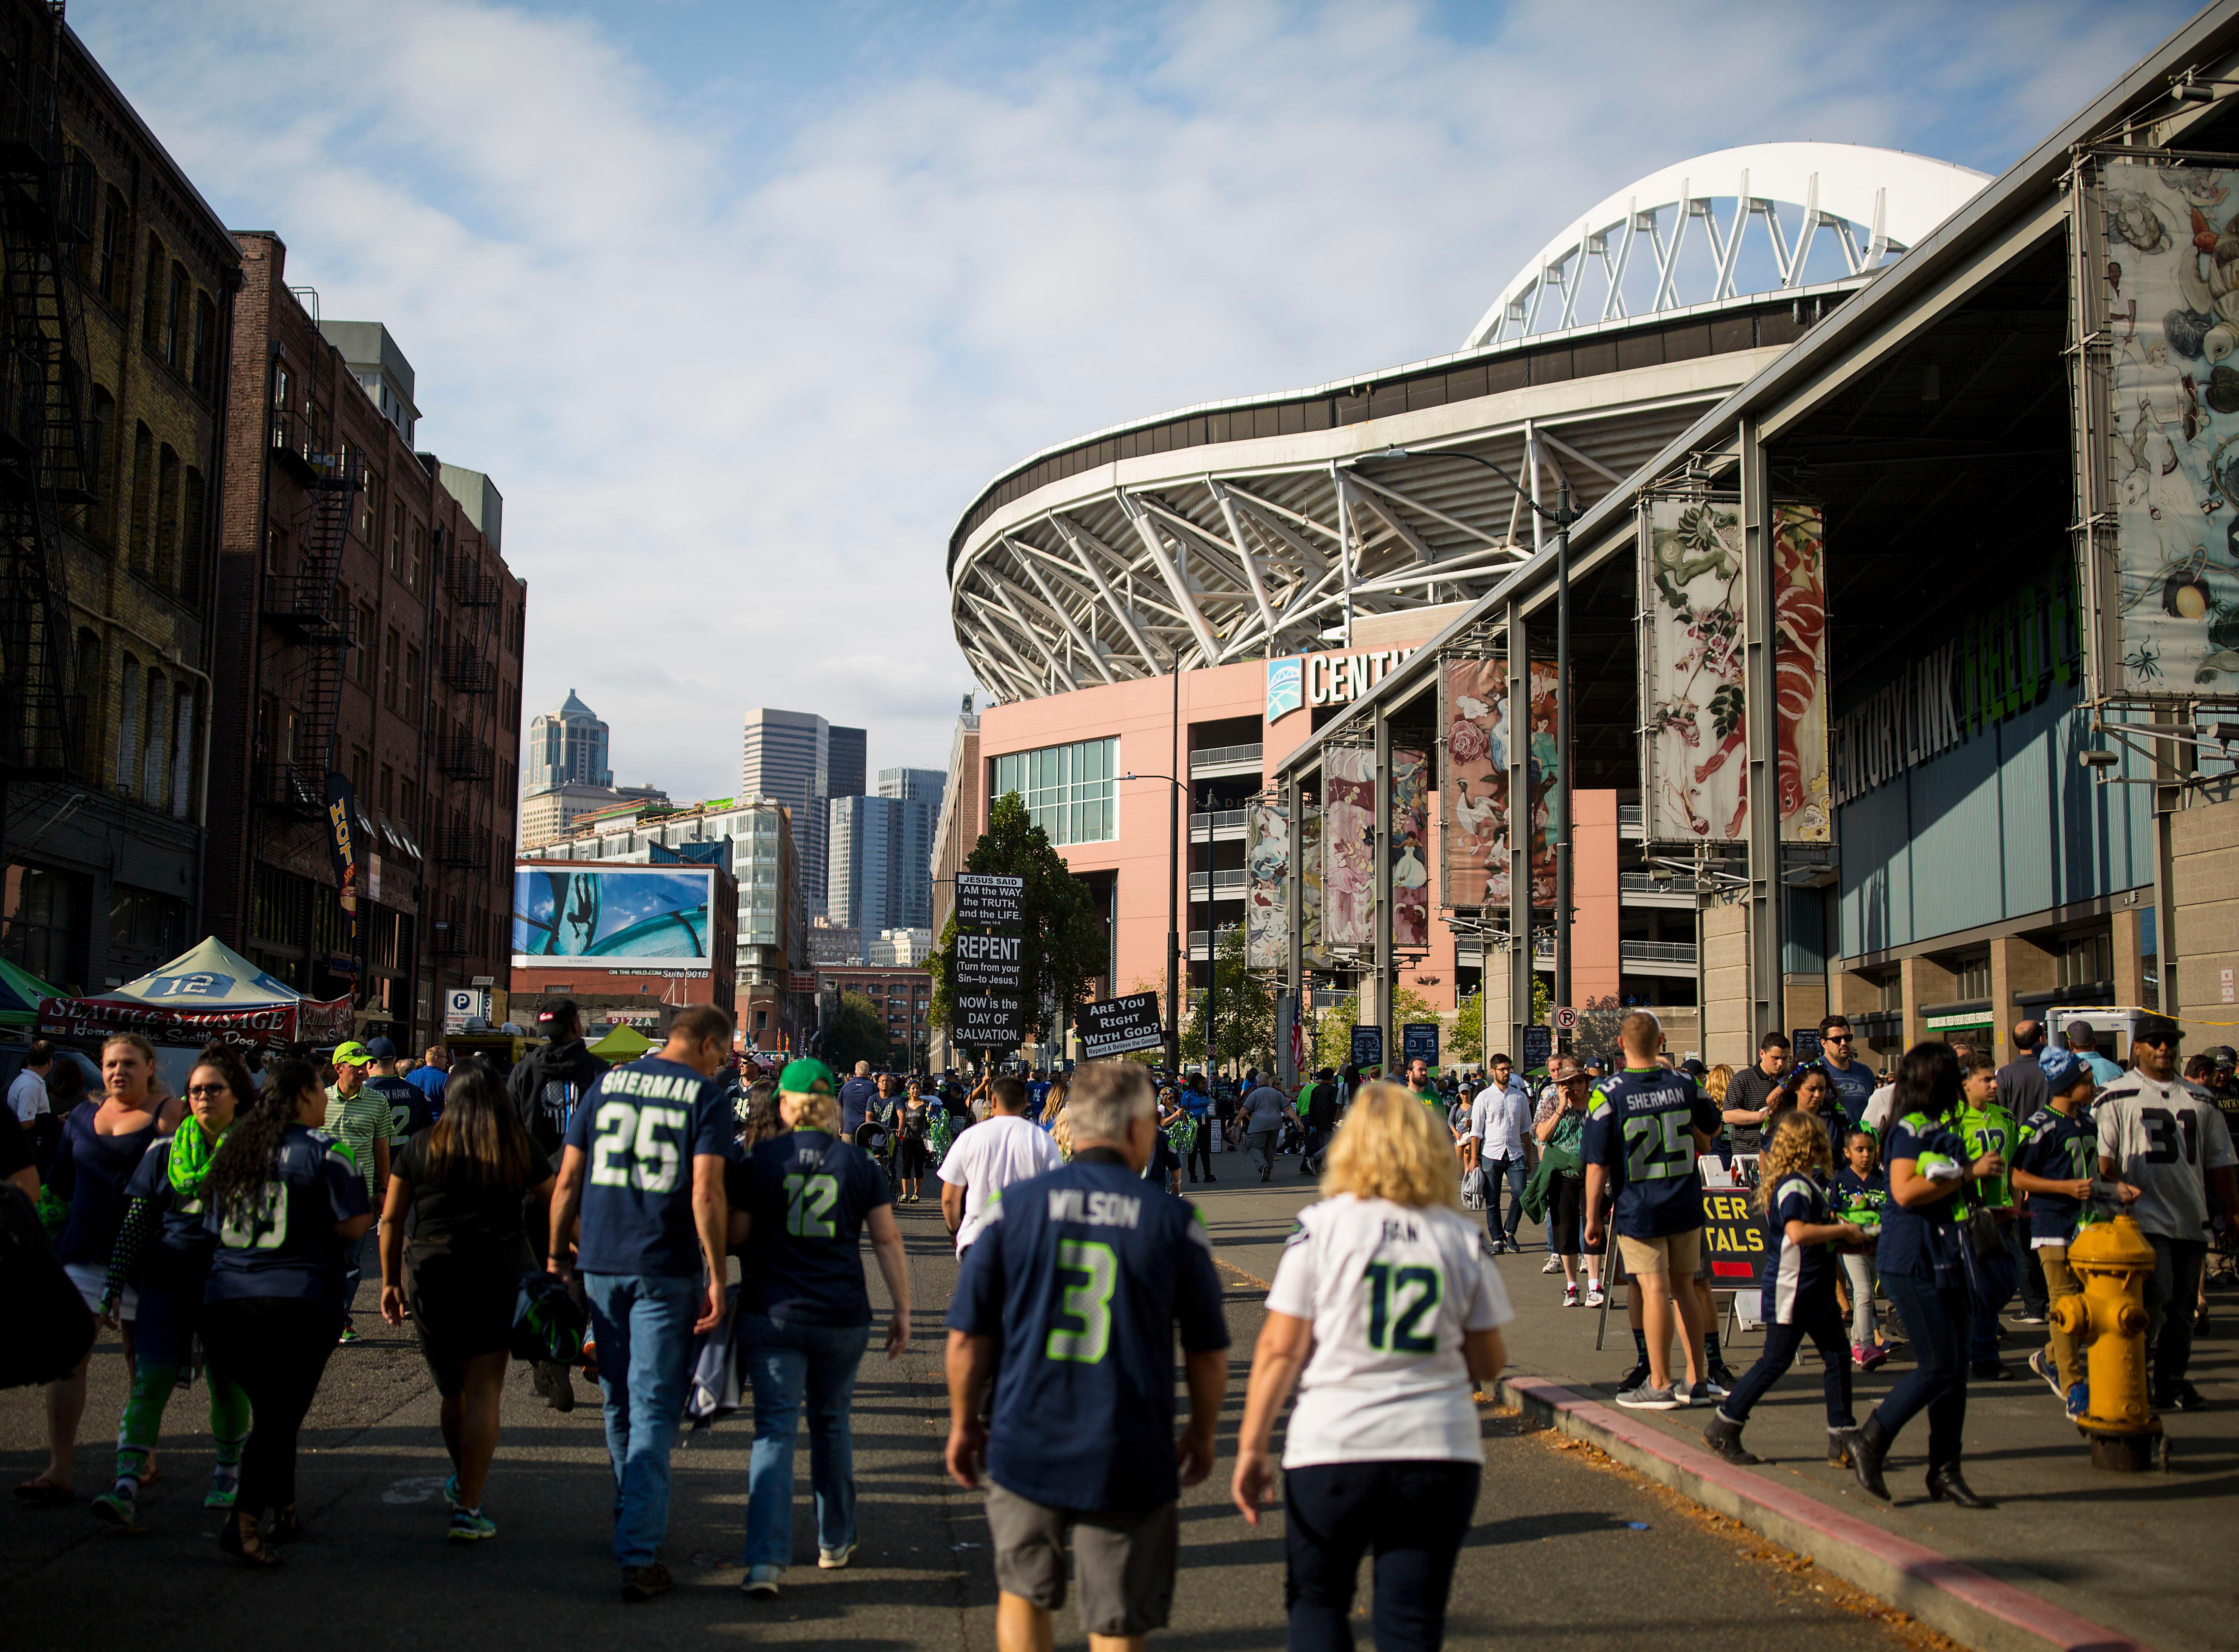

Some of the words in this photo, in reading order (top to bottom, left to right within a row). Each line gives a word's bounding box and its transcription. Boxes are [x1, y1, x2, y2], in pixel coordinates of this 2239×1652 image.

[1962, 581, 2040, 734] FIELD
[1309, 647, 1420, 703] CENT
[330, 796, 353, 866] HOT
[958, 885, 961, 893] I
[963, 886, 979, 894] AM
[982, 887, 997, 895] the
[999, 888, 1023, 898] WAY,
[963, 897, 978, 906] the
[981, 898, 1018, 909] TRUTH,
[979, 910, 995, 918] the
[998, 910, 1022, 920] LIFE.
[957, 935, 1021, 960] REPENT
[957, 961, 978, 972] (Turn
[981, 962, 999, 972] from
[1001, 965, 1020, 974] your
[163, 974, 214, 996] 12
[989, 975, 1018, 987] Jesus.)
[49, 998, 163, 1023] SEATTLE
[166, 1011, 286, 1030] SAUSAGE
[959, 997, 987, 1008] NOW
[990, 998, 998, 1008] is
[1001, 998, 1018, 1009] the
[612, 1018, 652, 1026] PIZZA
[968, 1013, 991, 1024] DAY
[994, 1014, 1009, 1024] OF
[74, 1021, 116, 1037] Home
[139, 1026, 162, 1040] the
[166, 1028, 220, 1043] Seattle
[222, 1031, 258, 1050] Dog
[956, 1028, 1019, 1040] SALVATION.
[1089, 1047, 1107, 1055] Repent
[1113, 1042, 1131, 1050] Believe
[1141, 1036, 1159, 1045] Gospel
[392, 1088, 411, 1099] HAWK
[600, 1069, 702, 1104] SHERMAN
[1626, 1086, 1685, 1111] SHERMAN
[590, 1100, 687, 1194] 25
[1623, 1108, 1695, 1181] 25
[2141, 1107, 2197, 1165] 31
[782, 1173, 838, 1238] 12
[1048, 1188, 1142, 1230] WILSON
[1382, 1218, 1418, 1242] FAN
[1046, 1238, 1118, 1365] 3
[1363, 1262, 1444, 1353] 12
